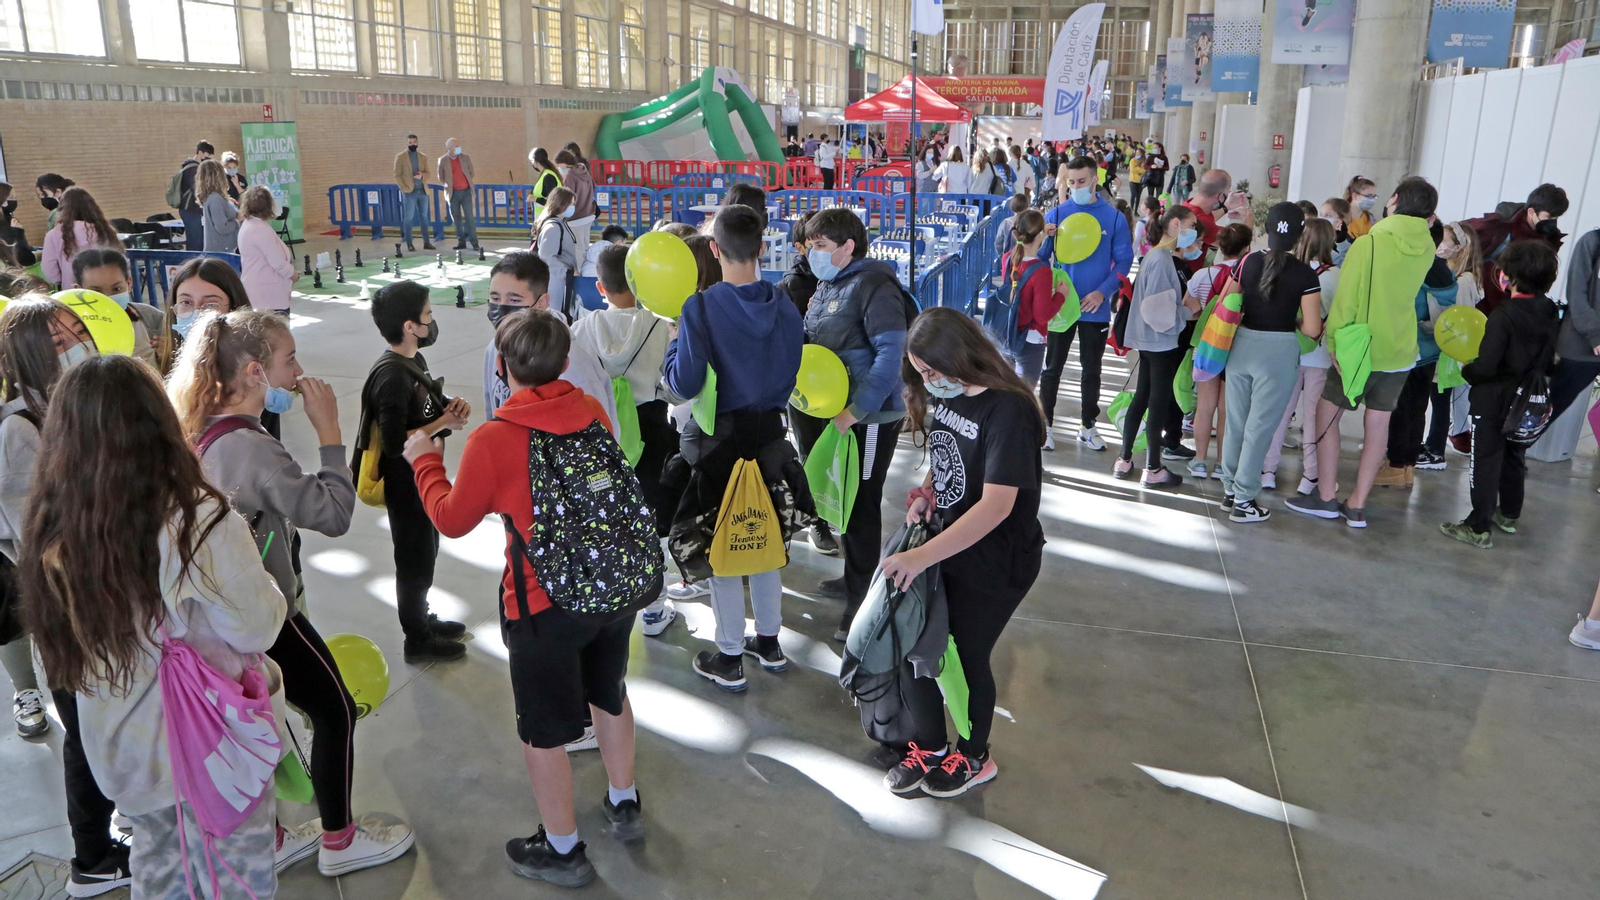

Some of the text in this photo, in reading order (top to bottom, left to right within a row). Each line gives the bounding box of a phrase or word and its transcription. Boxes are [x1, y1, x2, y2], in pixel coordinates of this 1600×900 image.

[1059, 21, 1081, 84] Diputación
[1076, 34, 1094, 86] de Cádiz
[935, 86, 1028, 96] TERCIO DE ARMADA
[246, 136, 295, 154] AJEDUCA
[934, 404, 979, 440] RAMONES
